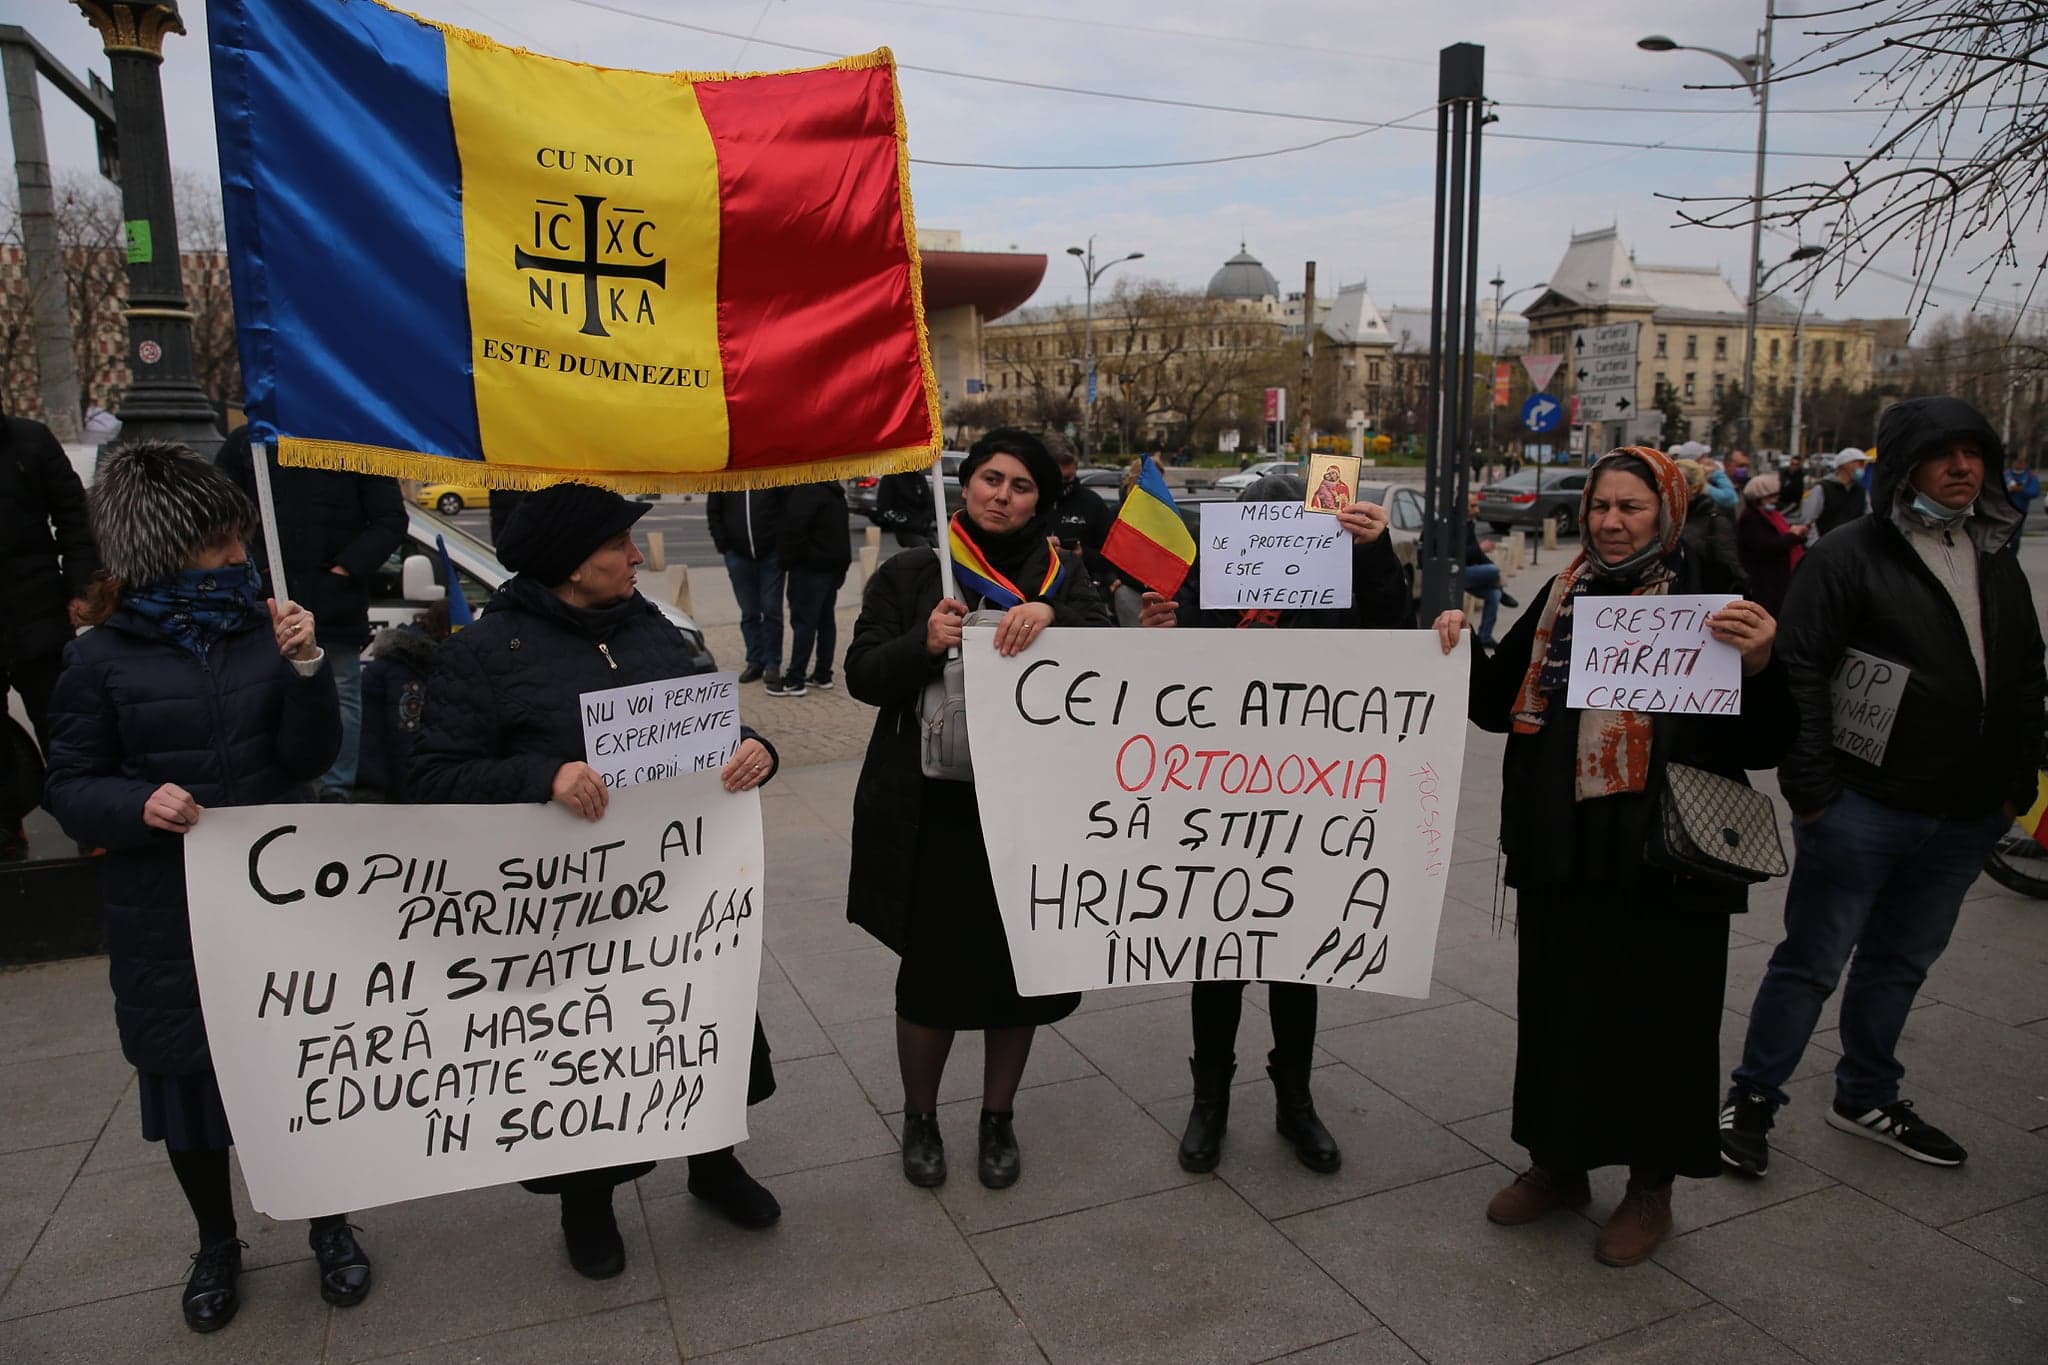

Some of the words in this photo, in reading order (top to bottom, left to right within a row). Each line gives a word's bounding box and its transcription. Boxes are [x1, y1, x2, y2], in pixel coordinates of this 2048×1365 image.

[536, 147, 576, 170] CU
[584, 154, 635, 176] NOI
[482, 338, 550, 370] ESTE
[558, 352, 711, 388] DUMNEZEU
[1240, 503, 1304, 521] MASCA
[1212, 536, 1230, 550] DE
[1224, 561, 1264, 576] ESTE
[1285, 564, 1300, 575] O
[586, 700, 614, 727] NU
[626, 688, 654, 716] VOI
[664, 681, 733, 710] PERMITE
[1014, 659, 1128, 726] CEI
[1155, 683, 1216, 728] CE
[1239, 680, 1435, 743] ATACAȚI
[595, 709, 736, 756] EXPERIMENTE
[601, 769, 628, 789] DE
[1115, 733, 1388, 804] ORTODOXIA
[498, 839, 626, 892] SUNT
[660, 815, 703, 863] AI
[1085, 796, 1151, 840] SĂ
[1178, 808, 1303, 859] ȘTIȚI
[1320, 808, 1378, 861] CĂ
[398, 869, 669, 941] PĂRINȚILOR
[1030, 863, 1295, 931] HRISTOS
[1342, 867, 1390, 929] A
[1104, 929, 1279, 985] ÎNVIAT
[257, 970, 337, 1018] NU
[365, 959, 416, 1007] AI
[297, 1007, 433, 1079] FĂRĂ
[463, 983, 613, 1053] MASCĂ
[641, 982, 693, 1036] ȘI
[425, 1107, 471, 1157] ÎN
